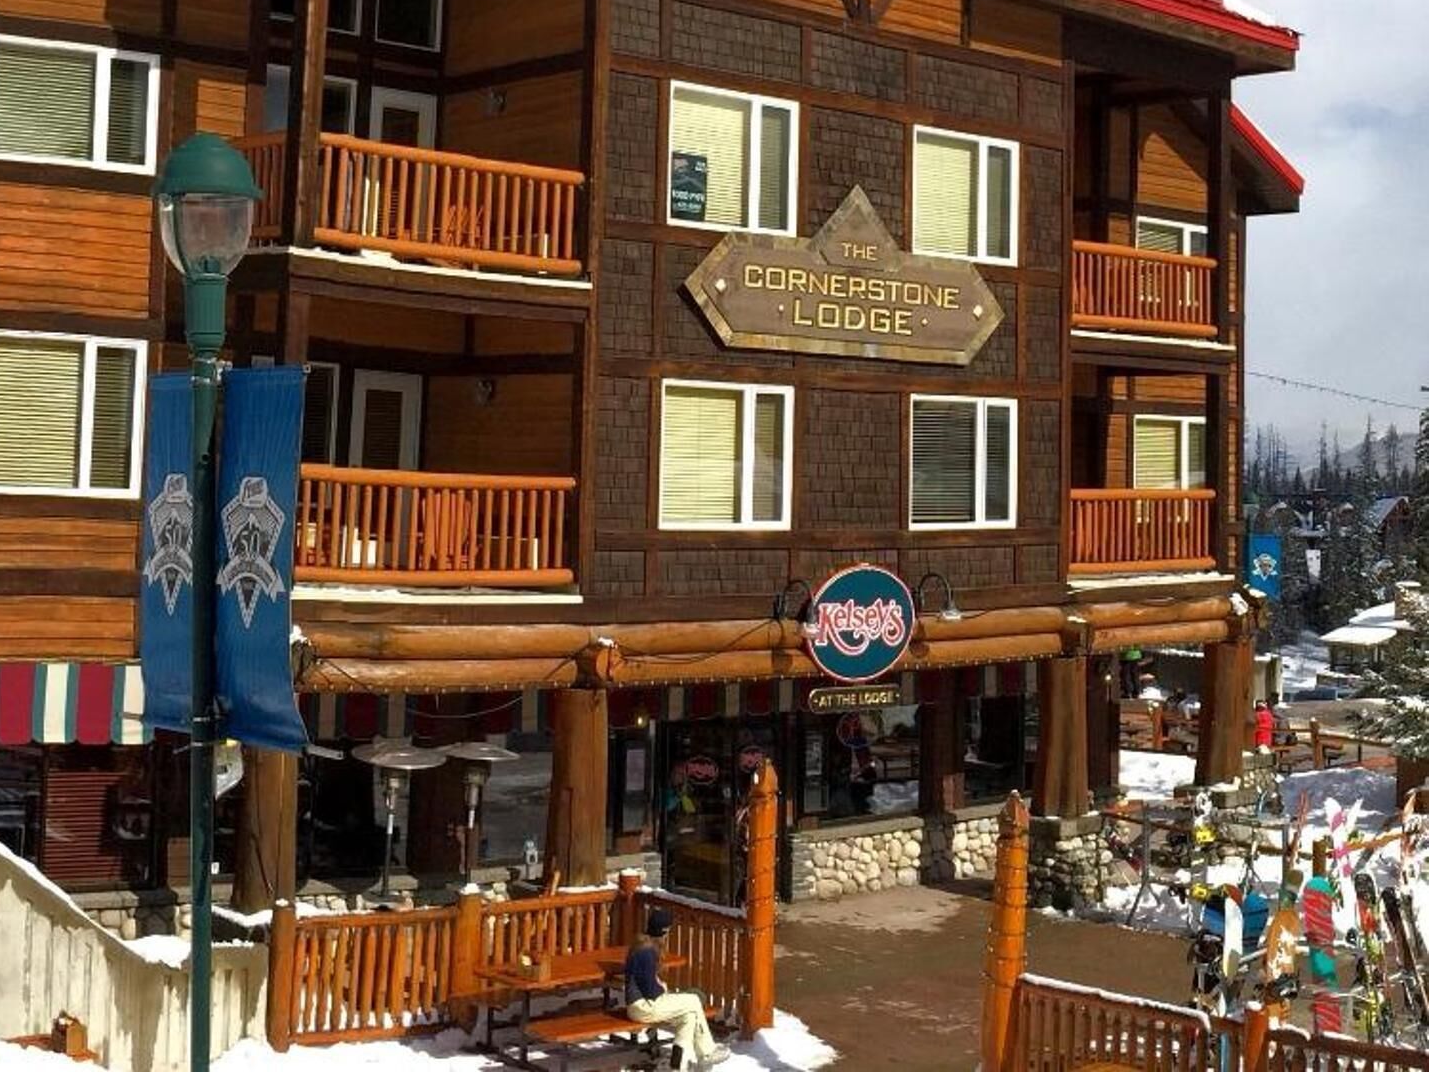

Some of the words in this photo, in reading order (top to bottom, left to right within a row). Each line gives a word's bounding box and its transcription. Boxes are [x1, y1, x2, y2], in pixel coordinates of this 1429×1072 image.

[841, 242, 878, 262] THE
[744, 265, 960, 309] CORNERSTONE
[793, 299, 913, 335] LODGE
[240, 530, 261, 560] 50
[815, 598, 905, 655] Kelsey's
[819, 695, 833, 707] AT
[837, 693, 857, 705] THE
[859, 692, 893, 705] LODGE
